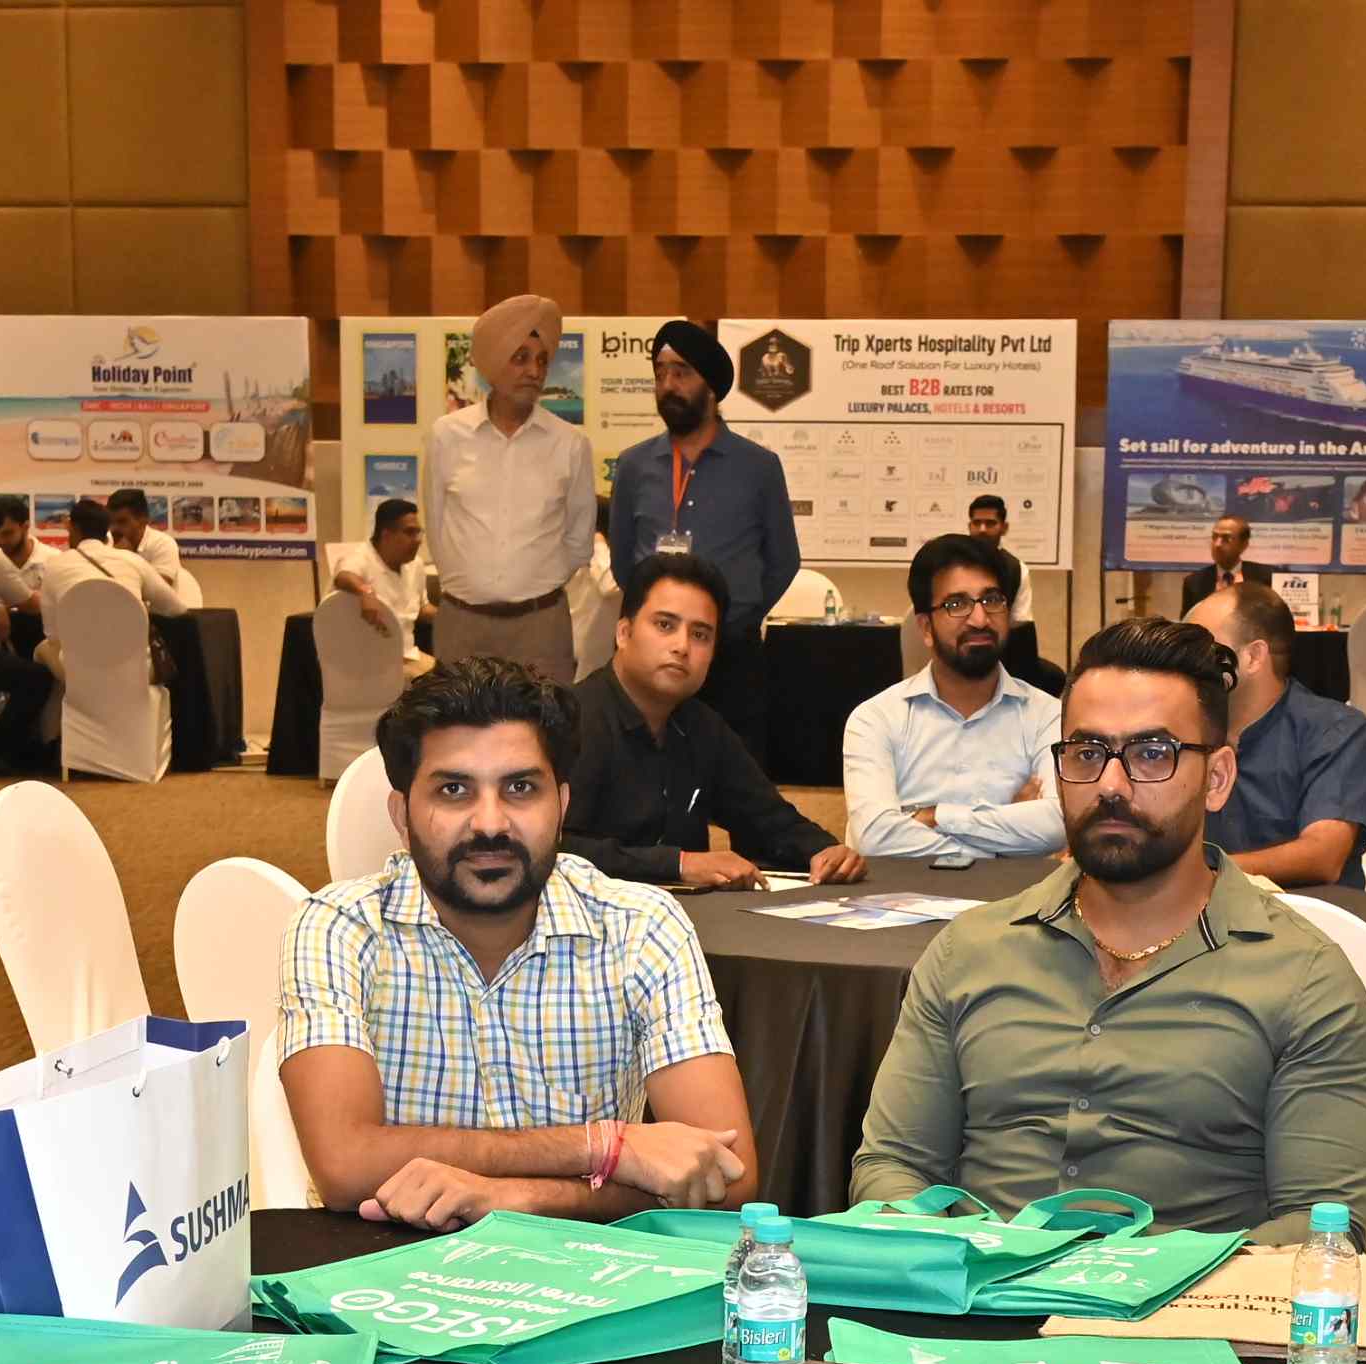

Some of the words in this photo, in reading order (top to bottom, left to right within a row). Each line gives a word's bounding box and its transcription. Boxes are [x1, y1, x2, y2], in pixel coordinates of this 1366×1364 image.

[834, 334, 859, 354] Trip
[865, 334, 912, 353] Xperts
[918, 335, 994, 355] Hospitality
[1001, 336, 1025, 353] Pvt
[1031, 335, 1052, 352] Ltd
[92, 366, 149, 384] Holiday
[154, 366, 193, 383] Point
[842, 360, 867, 371] (One
[871, 361, 895, 370] Roof
[898, 361, 940, 371] Solution
[945, 361, 961, 371] For
[964, 361, 1000, 373] Luxury
[1006, 361, 1041, 372] Hotels)
[881, 385, 905, 396] BEST
[908, 378, 941, 396] B2B
[943, 386, 973, 396] RATES
[975, 386, 994, 396] FOR
[848, 402, 885, 414] LUXURY
[887, 402, 932, 415] PALACES,
[934, 403, 971, 414] HOTELS
[972, 403, 981, 414] &
[983, 403, 1026, 415] RESORTS
[1118, 438, 1147, 453] Set
[1150, 438, 1180, 453] sail
[1182, 438, 1208, 454] for
[1210, 440, 1296, 455] adventure
[1299, 440, 1315, 455] in
[1318, 440, 1347, 455] the
[179, 545, 308, 559] ww.theholidaypoint.com
[170, 1172, 250, 1262] SUSHMA
[407, 1271, 533, 1297] Insurance
[330, 1288, 557, 1339] ASEGO
[1291, 1312, 1313, 1328] leri
[741, 1327, 787, 1345] Bisleri
